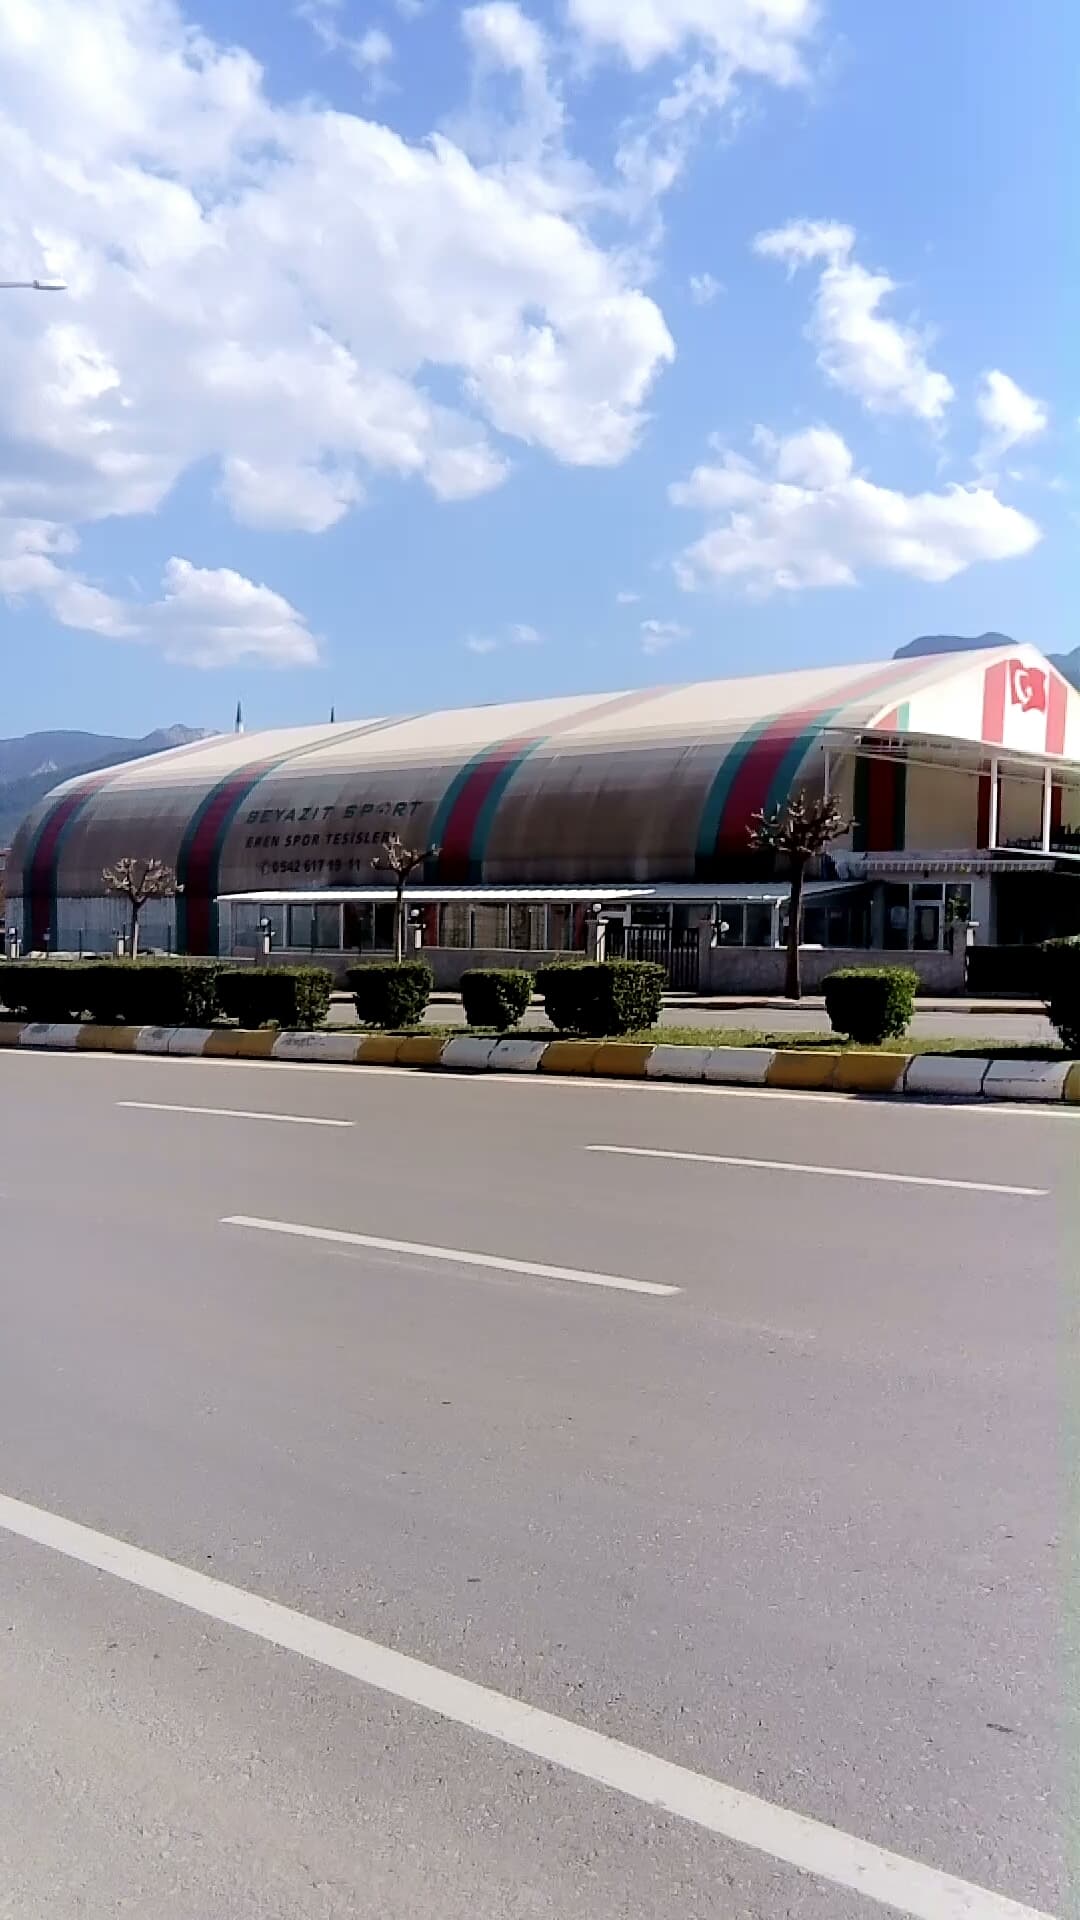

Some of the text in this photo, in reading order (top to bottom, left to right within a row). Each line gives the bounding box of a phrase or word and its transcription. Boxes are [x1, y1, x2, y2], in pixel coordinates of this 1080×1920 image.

[246, 806, 335, 824] BEYAZIT
[245, 835, 280, 848] EREN
[284, 834, 320, 847] SPOR
[272, 859, 300, 873] 0542
